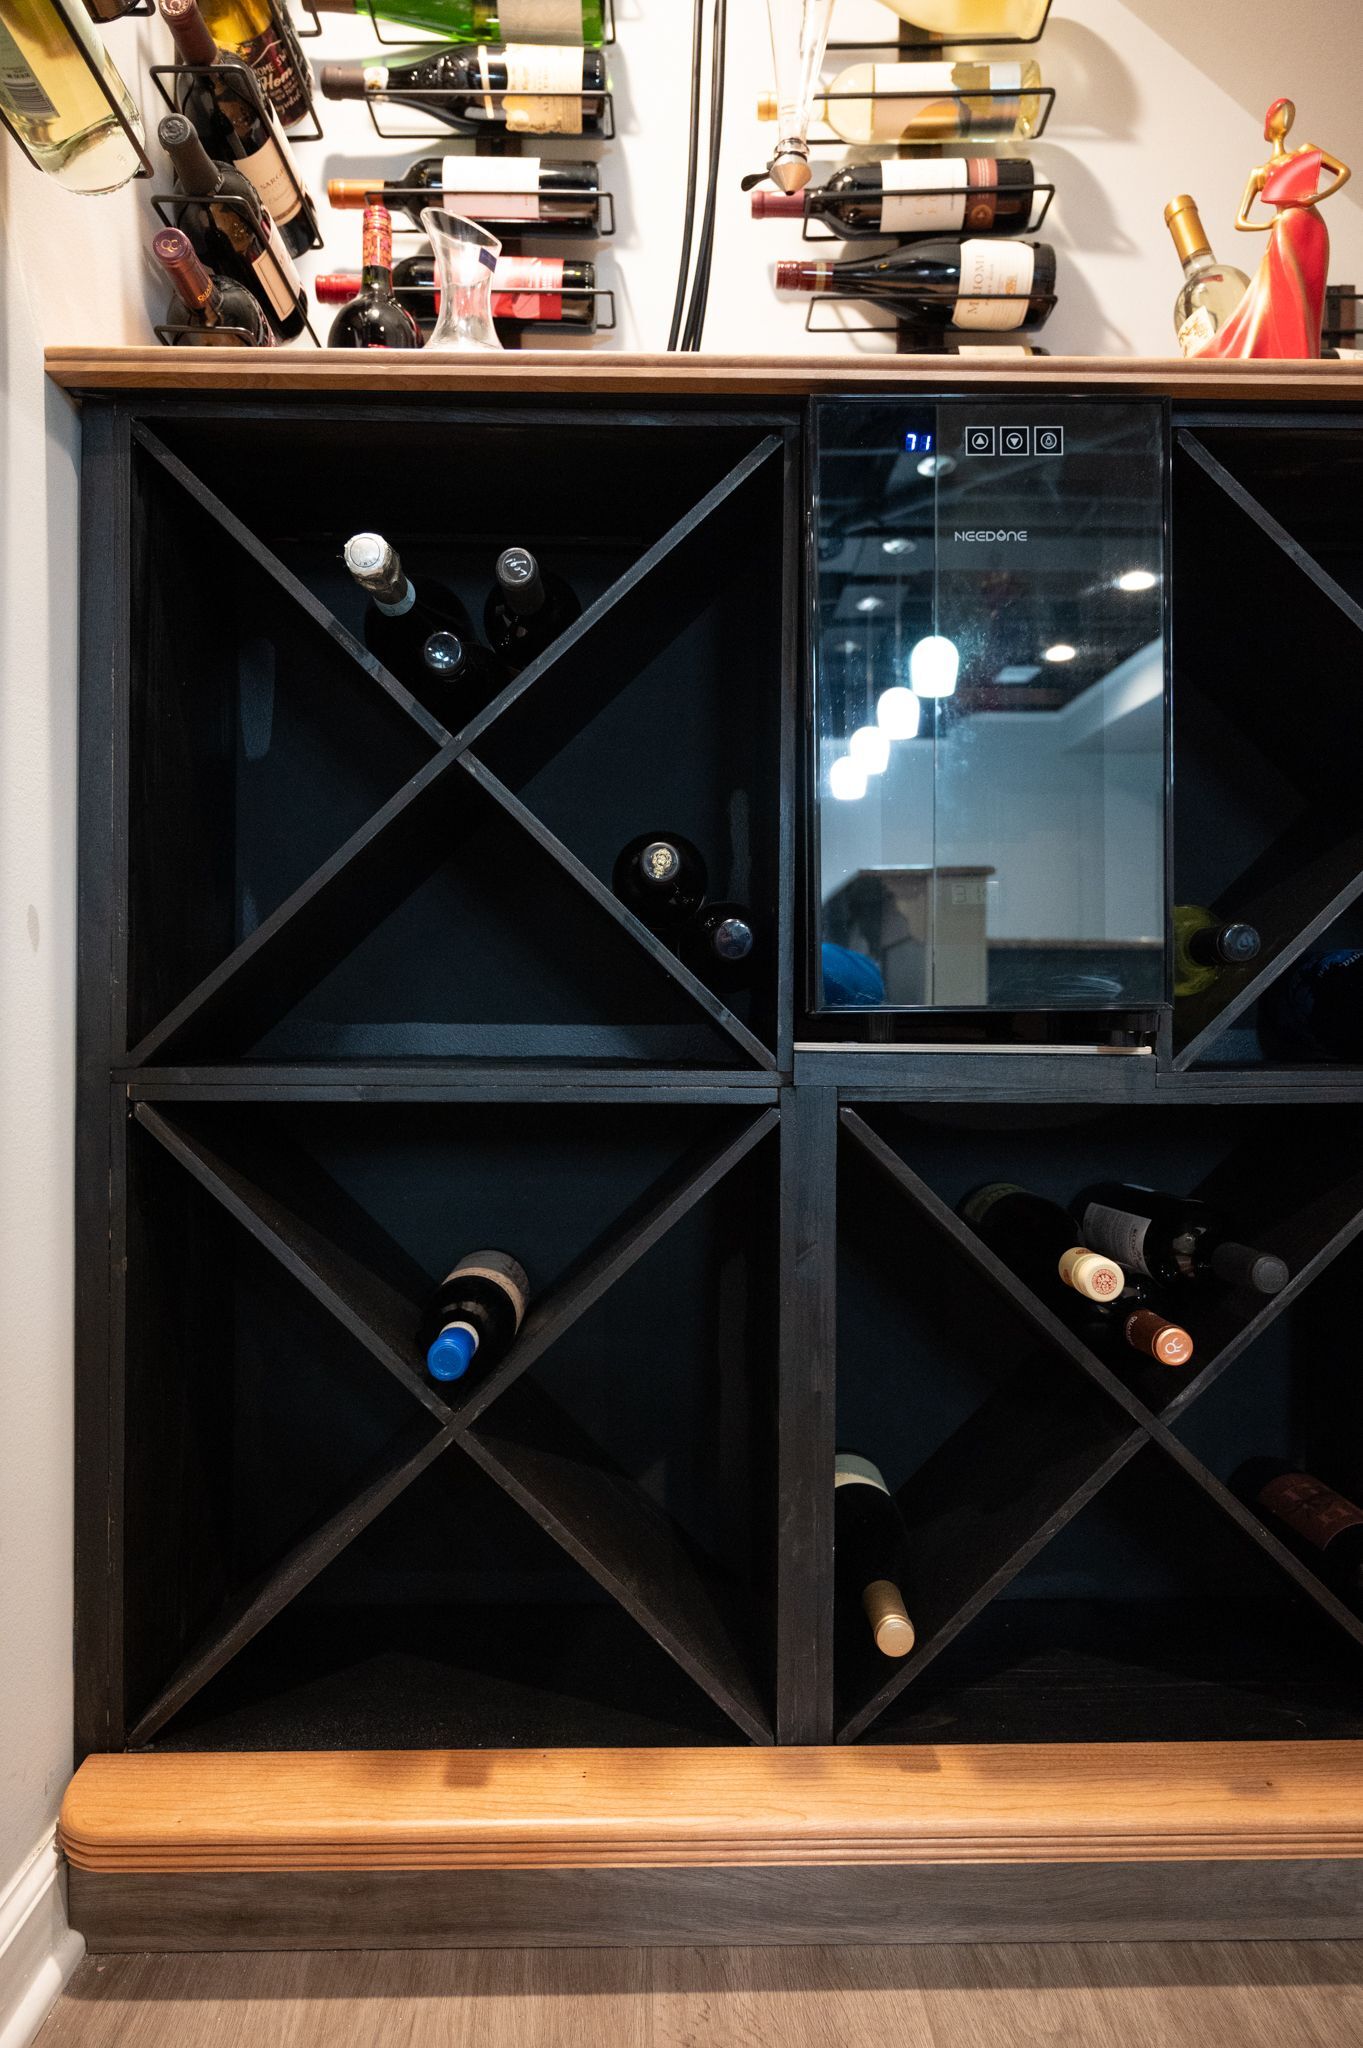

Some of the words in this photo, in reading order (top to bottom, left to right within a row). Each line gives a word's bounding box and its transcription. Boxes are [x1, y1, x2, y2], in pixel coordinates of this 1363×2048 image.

[260, 67, 293, 91] Hom
[967, 255, 985, 315] MIOMI
[907, 433, 932, 451] 71
[954, 529, 1028, 541] NEEDONE
